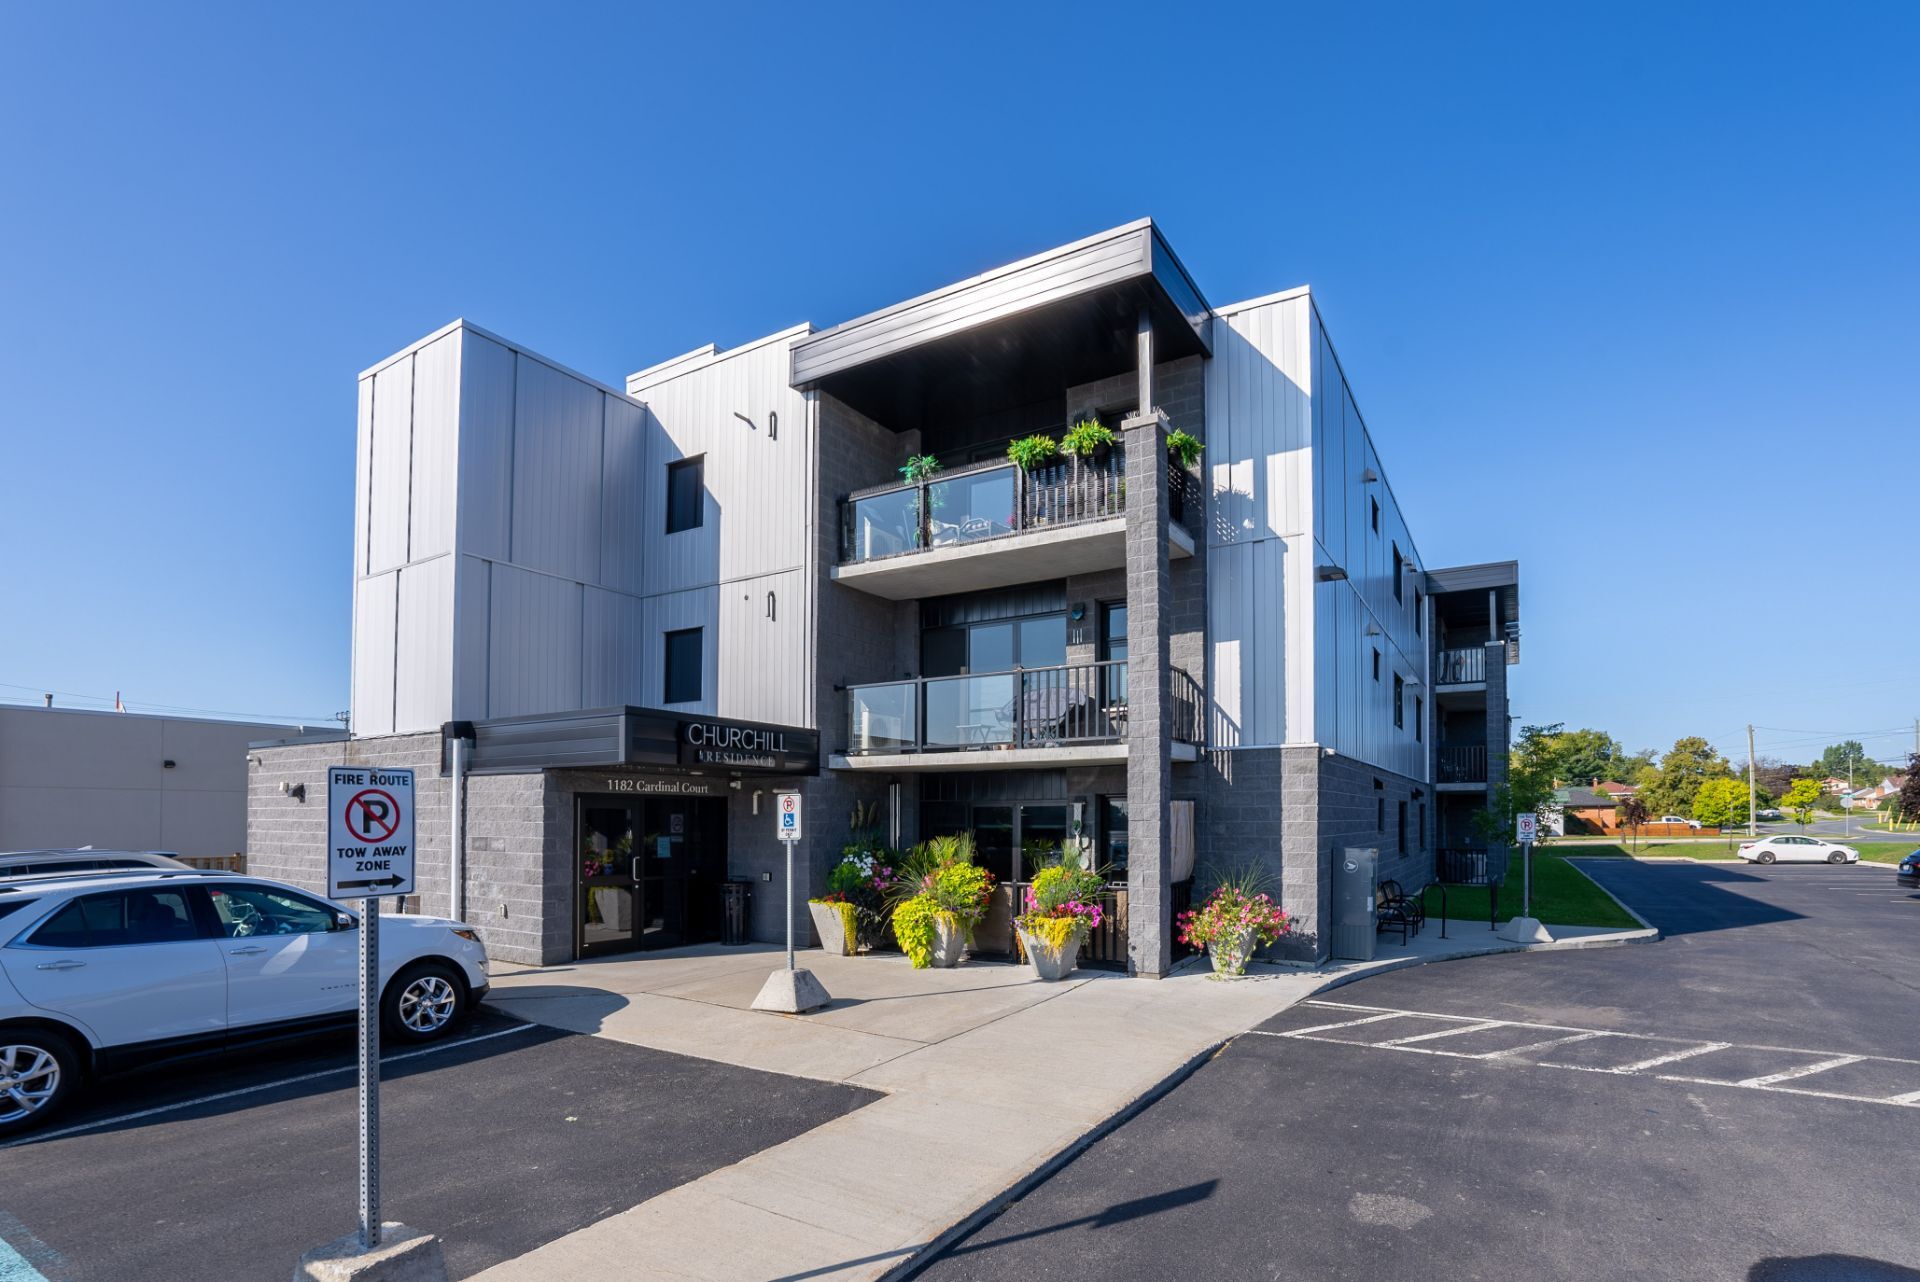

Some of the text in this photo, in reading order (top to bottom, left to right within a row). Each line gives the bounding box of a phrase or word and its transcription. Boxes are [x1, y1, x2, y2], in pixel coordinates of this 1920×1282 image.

[688, 723, 789, 753] CHURCHILL
[706, 750, 774, 767] RESIDENCE
[334, 773, 410, 786] FIRE ROUTE
[607, 780, 709, 794] 1182 Cardinal Court
[336, 845, 408, 858] TOW AWAY
[355, 860, 391, 872] ZONE
